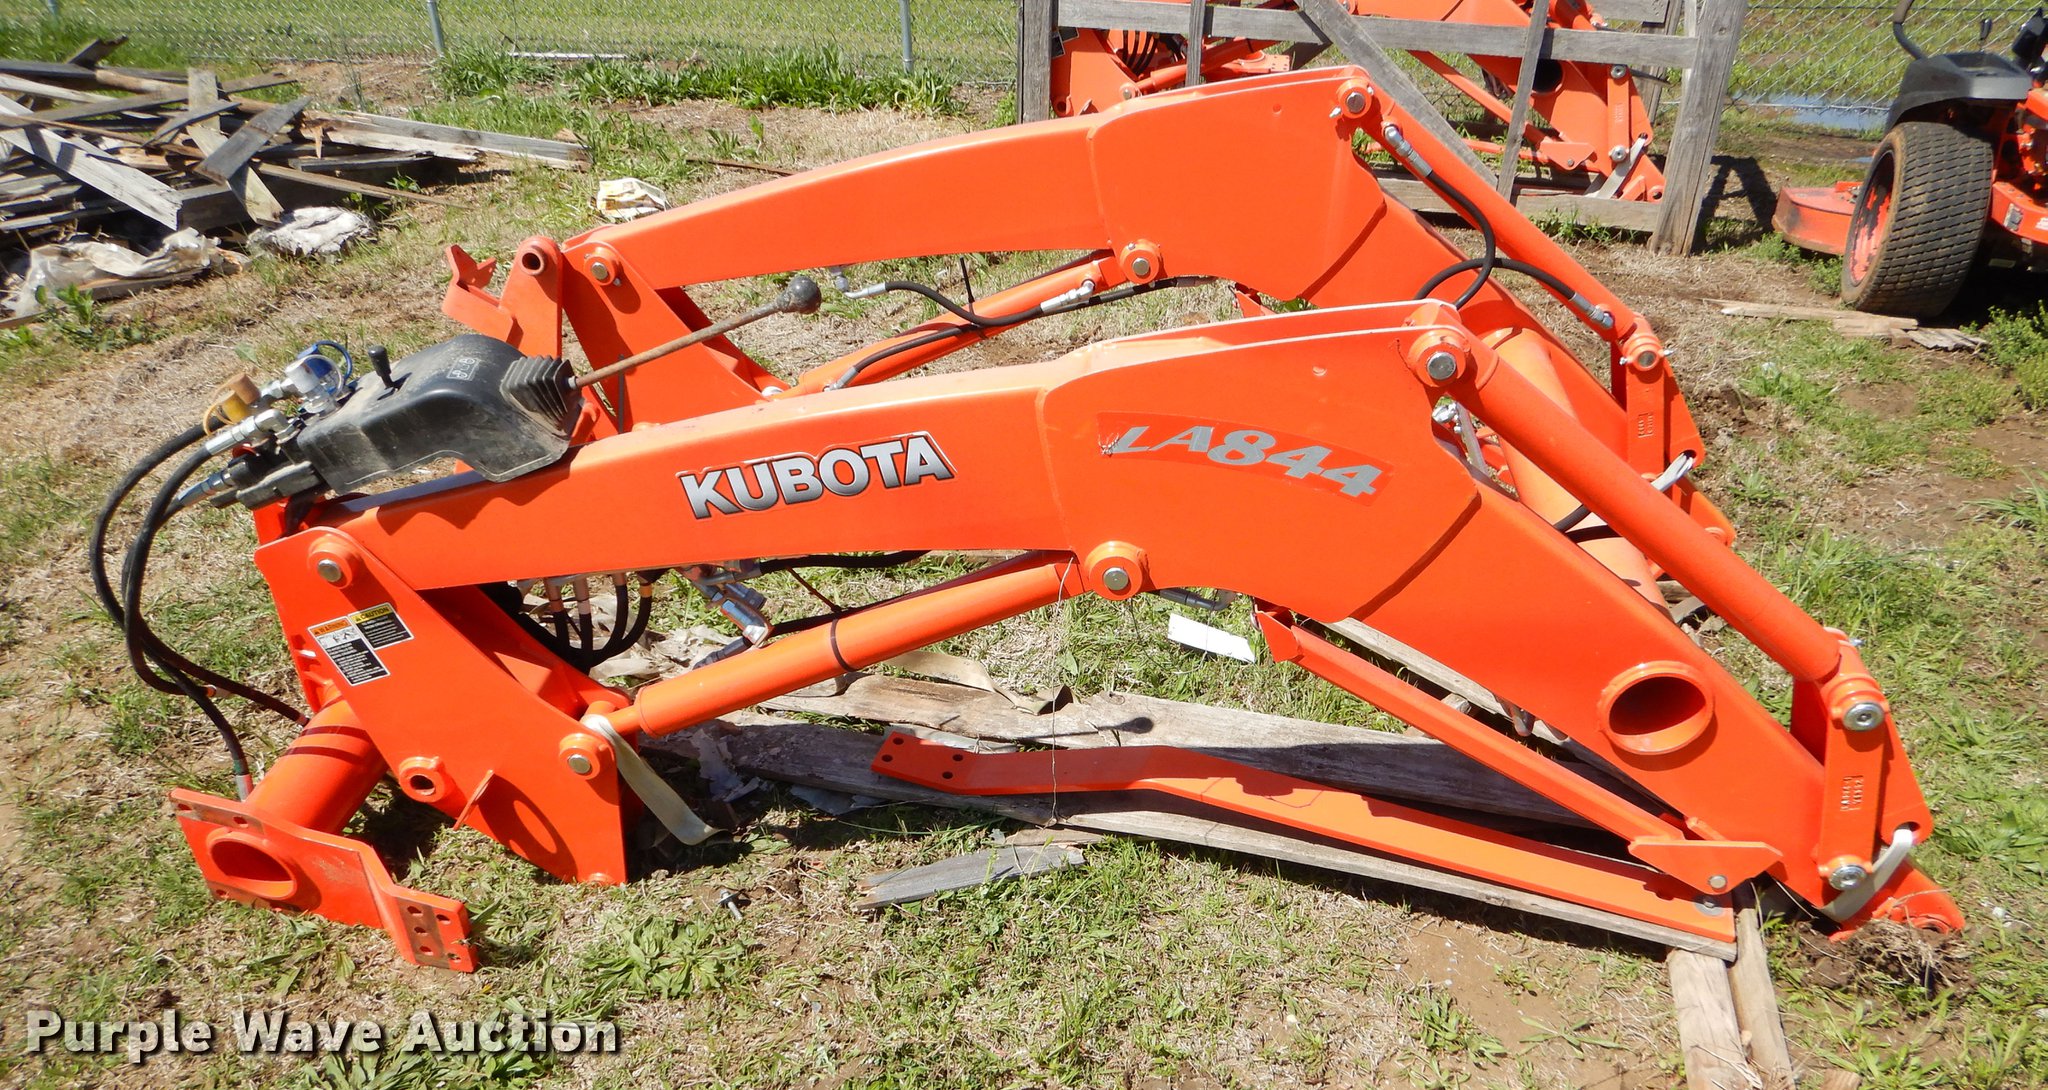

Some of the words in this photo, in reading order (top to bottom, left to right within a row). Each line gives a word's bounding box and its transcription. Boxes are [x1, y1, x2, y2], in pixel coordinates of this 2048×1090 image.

[678, 434, 955, 519] KUBOTA
[1106, 425, 1383, 498] LA844
[360, 606, 390, 620] CAUTION
